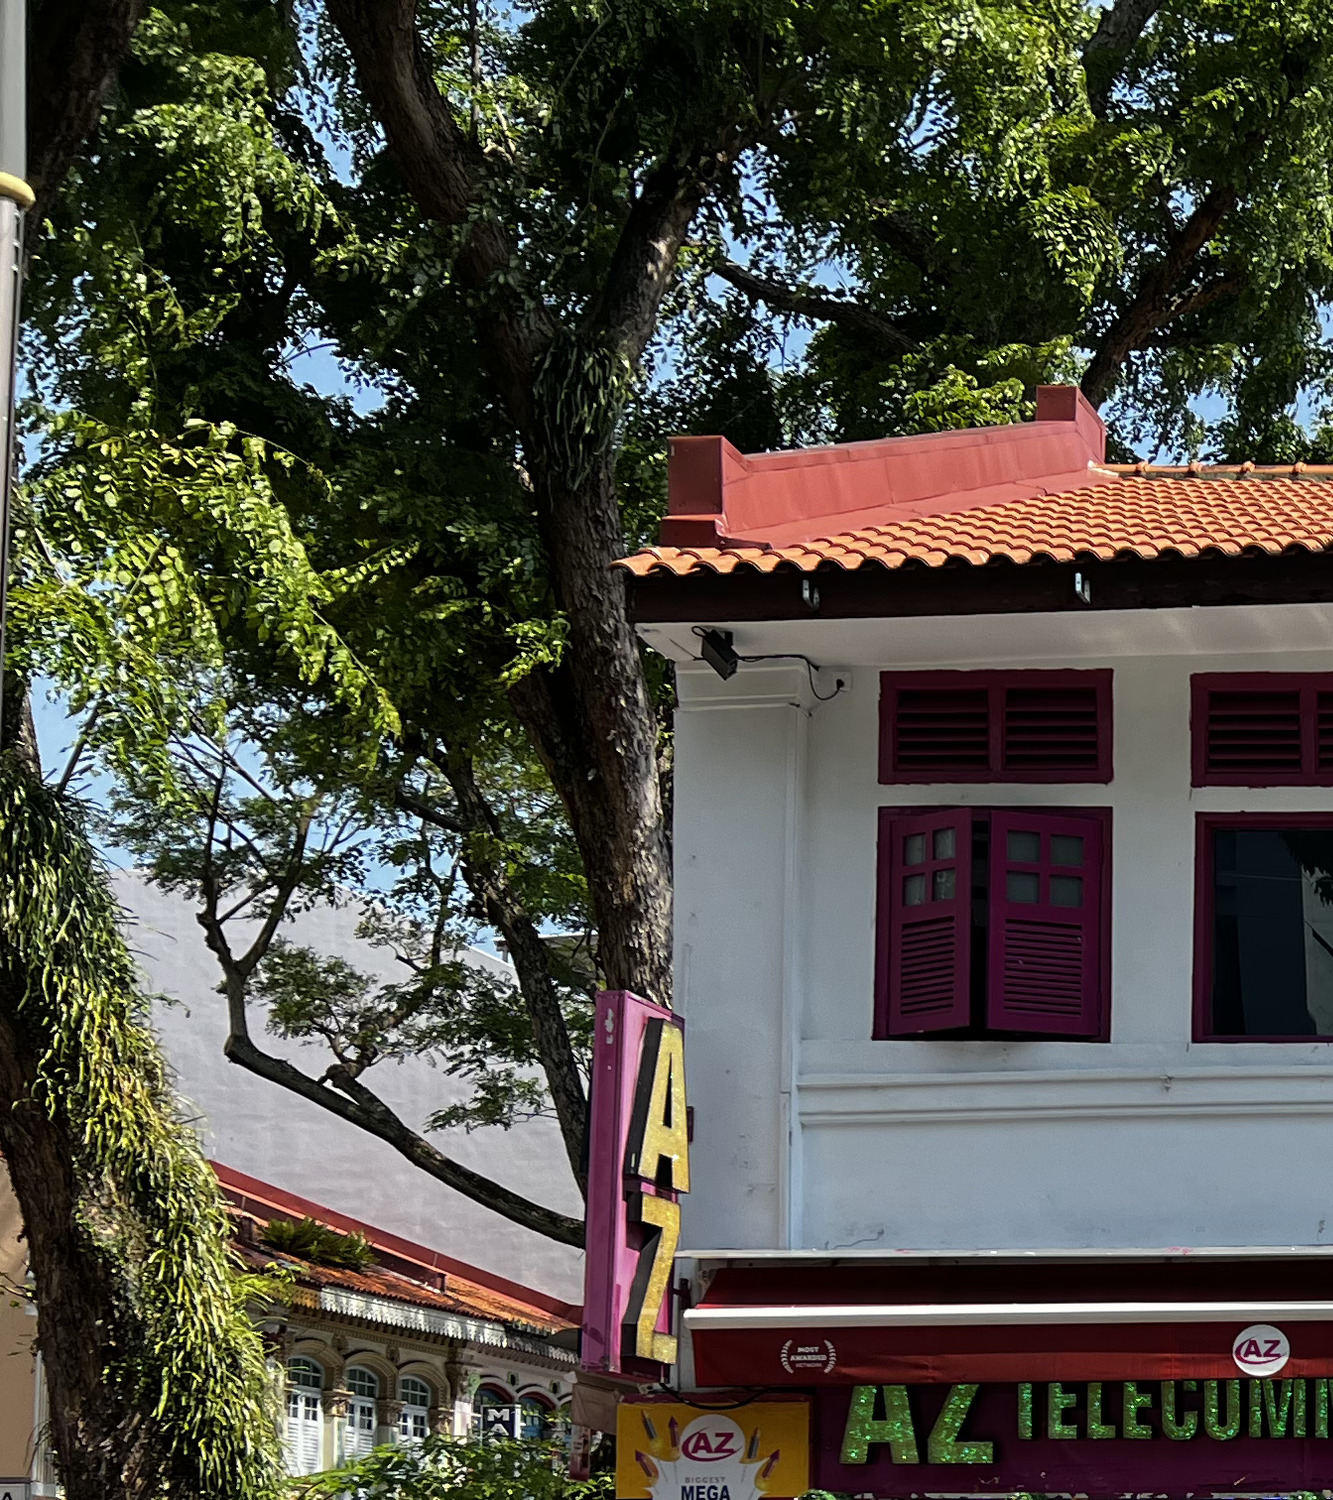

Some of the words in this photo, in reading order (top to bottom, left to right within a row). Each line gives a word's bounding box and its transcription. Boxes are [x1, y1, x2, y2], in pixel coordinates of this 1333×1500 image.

[636, 1021, 691, 1365] AZ
[1240, 1339, 1282, 1360] AZ
[839, 1383, 994, 1465] AZ
[686, 1430, 736, 1457] AZ
[684, 1476, 727, 1484] BIGGEST
